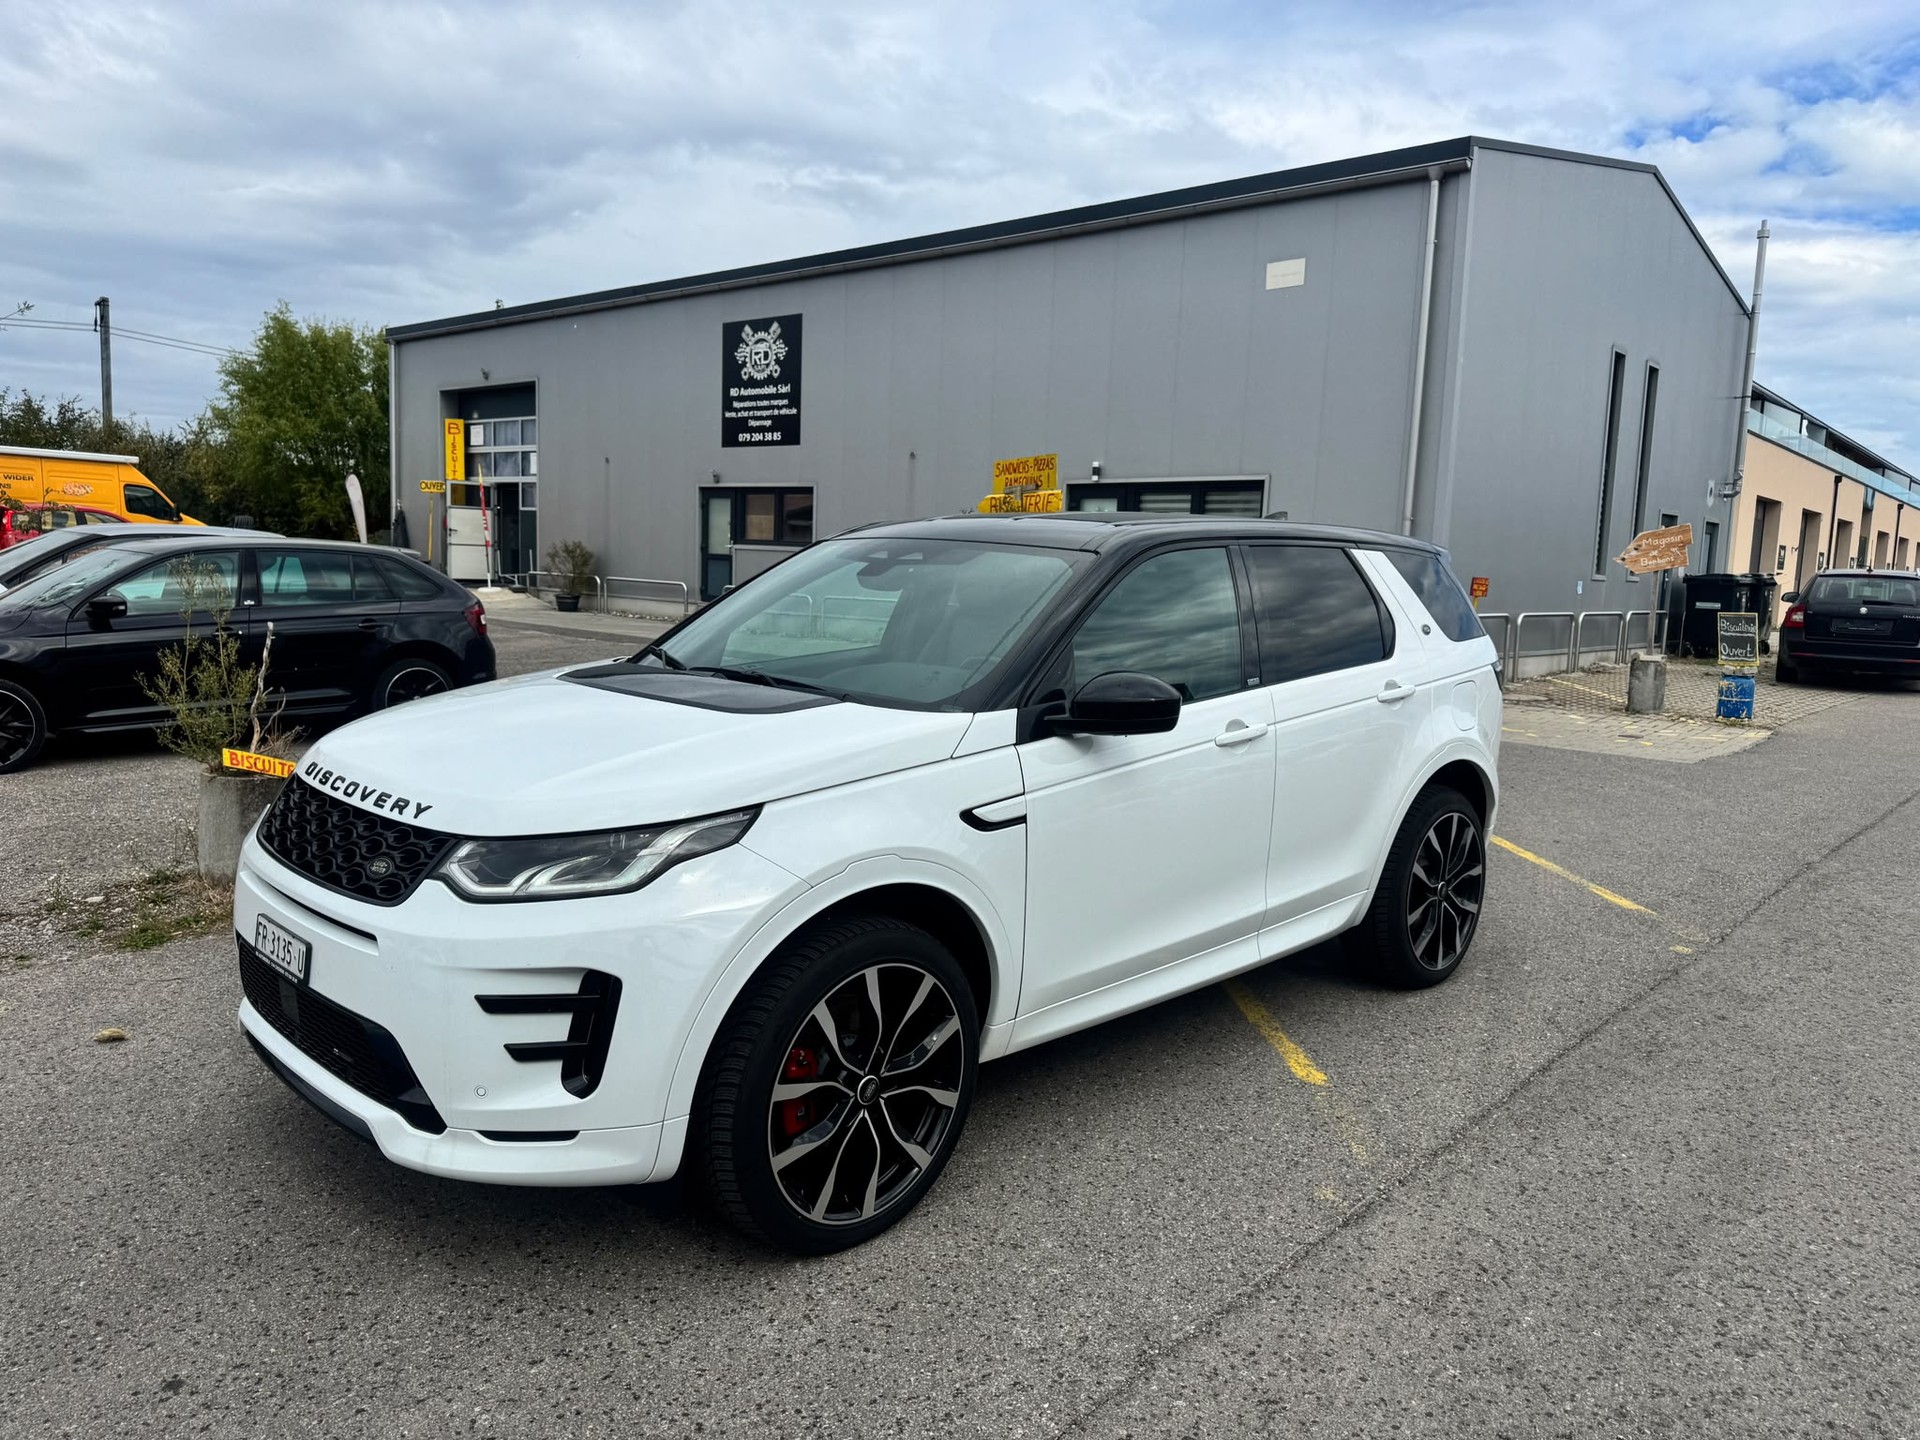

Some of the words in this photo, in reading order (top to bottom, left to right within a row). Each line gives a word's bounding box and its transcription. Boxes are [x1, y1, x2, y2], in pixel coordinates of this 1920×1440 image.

[751, 349, 772, 365] RD
[730, 388, 739, 397] RD
[740, 385, 777, 396] Automobile
[738, 433, 751, 442] 079
[751, 432, 764, 442] 204
[764, 432, 773, 441] 38
[773, 432, 782, 441] 85
[448, 422, 461, 480] BISCUIT
[1642, 535, 1684, 548] Magasin
[1721, 642, 1755, 657] Ouvert
[304, 761, 433, 820] DISCOVERY
